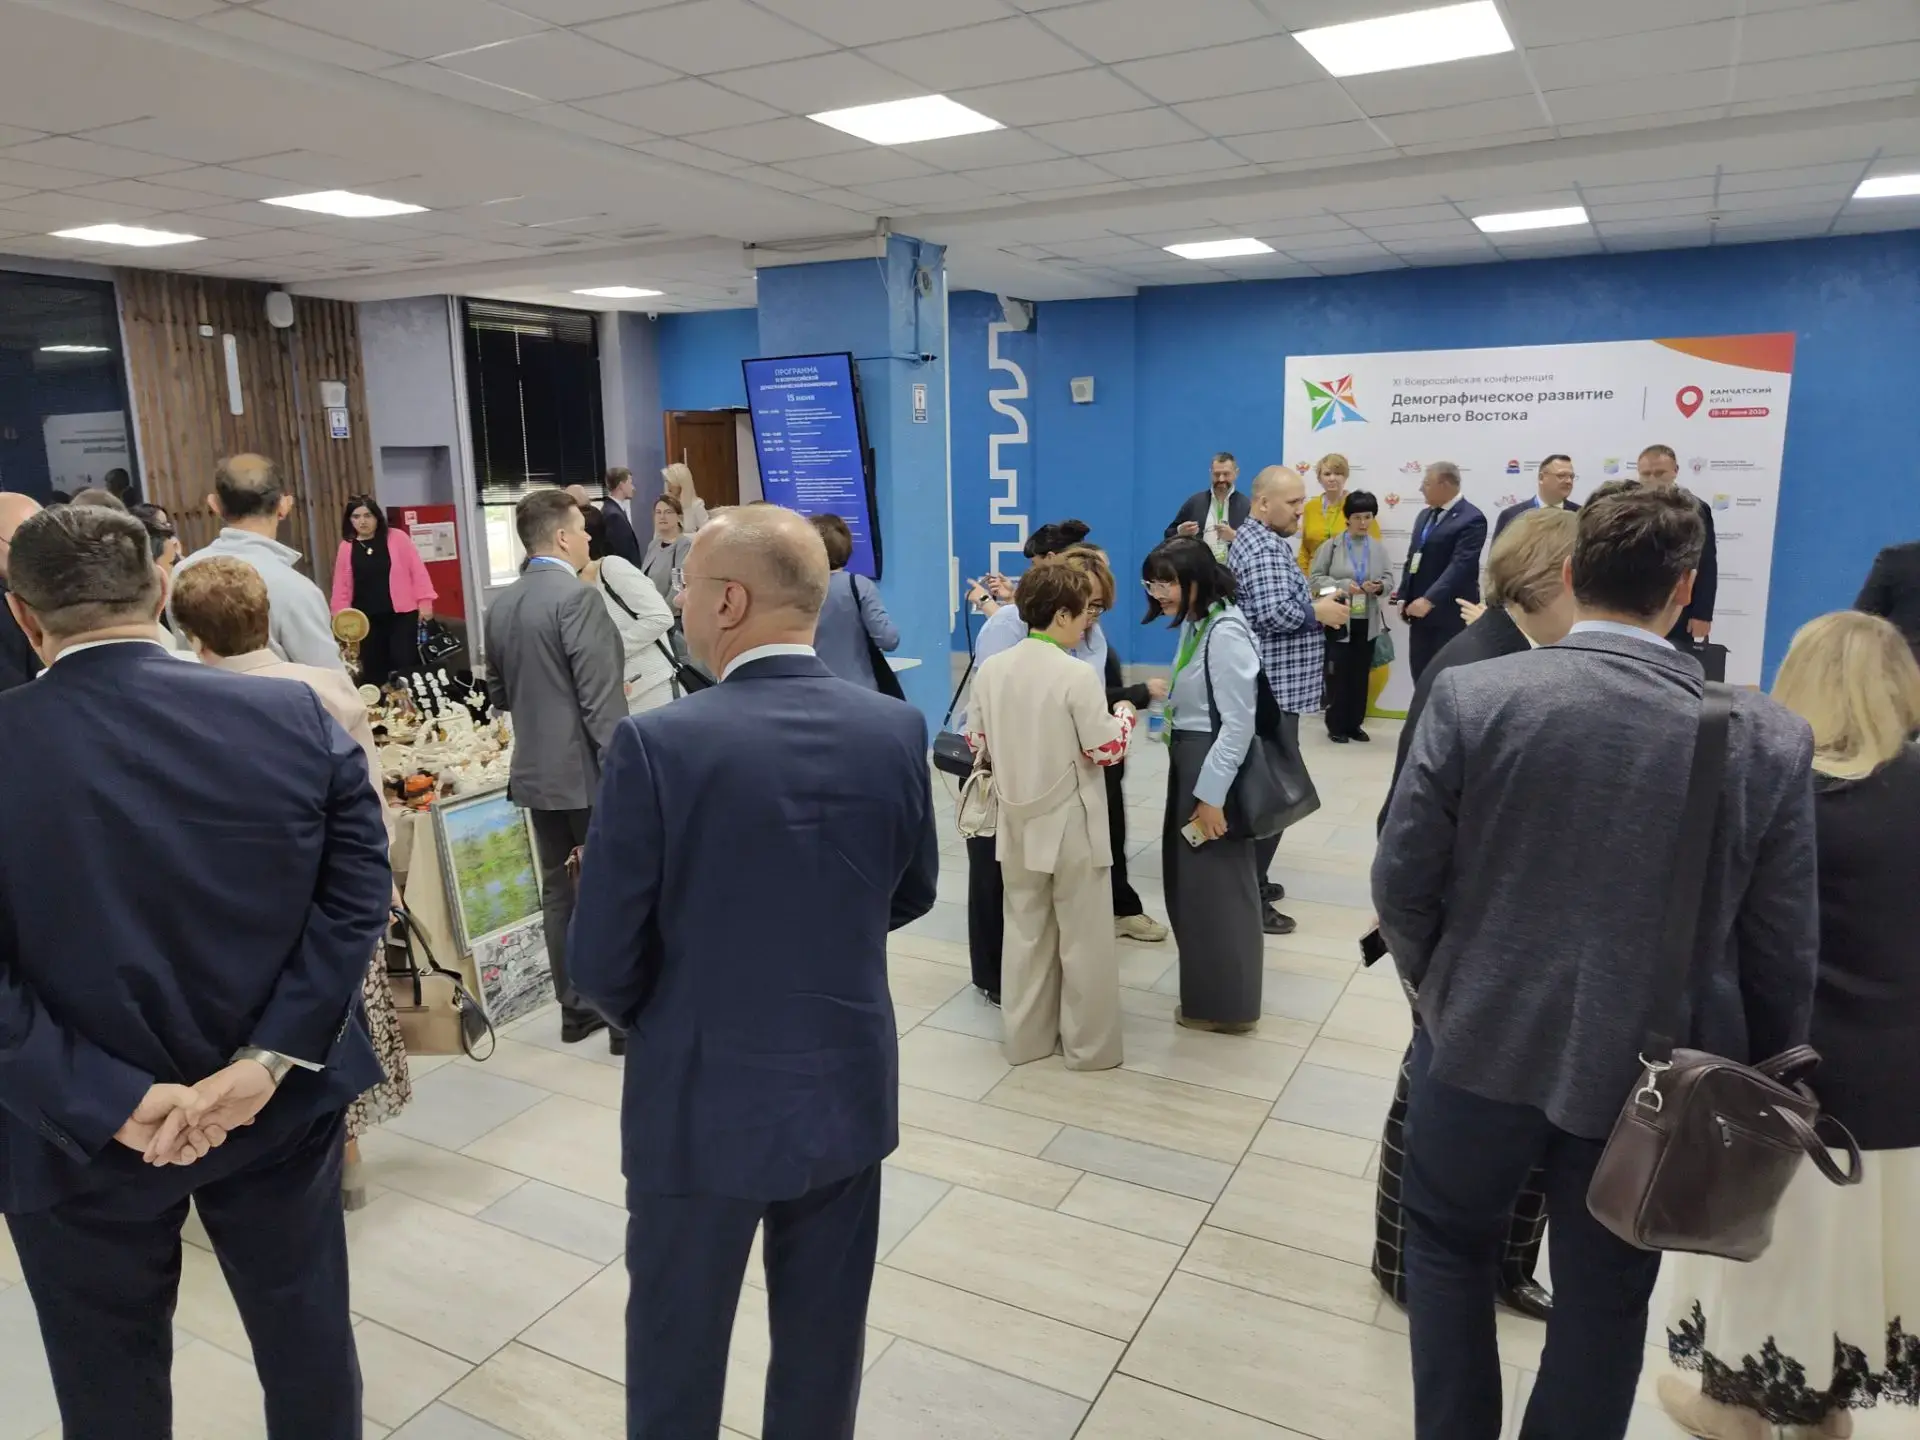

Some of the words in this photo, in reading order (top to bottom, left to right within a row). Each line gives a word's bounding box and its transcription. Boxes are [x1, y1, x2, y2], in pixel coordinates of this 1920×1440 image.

[1404, 375, 1481, 387] Всероссийская
[1484, 373, 1554, 385] конференция
[1710, 385, 1772, 395] КАМЧАТСКИЙ
[1392, 391, 1534, 407] Демографическое
[1538, 389, 1614, 404] развитие
[1391, 411, 1461, 425] Дальнего
[1465, 410, 1528, 422] Востока
